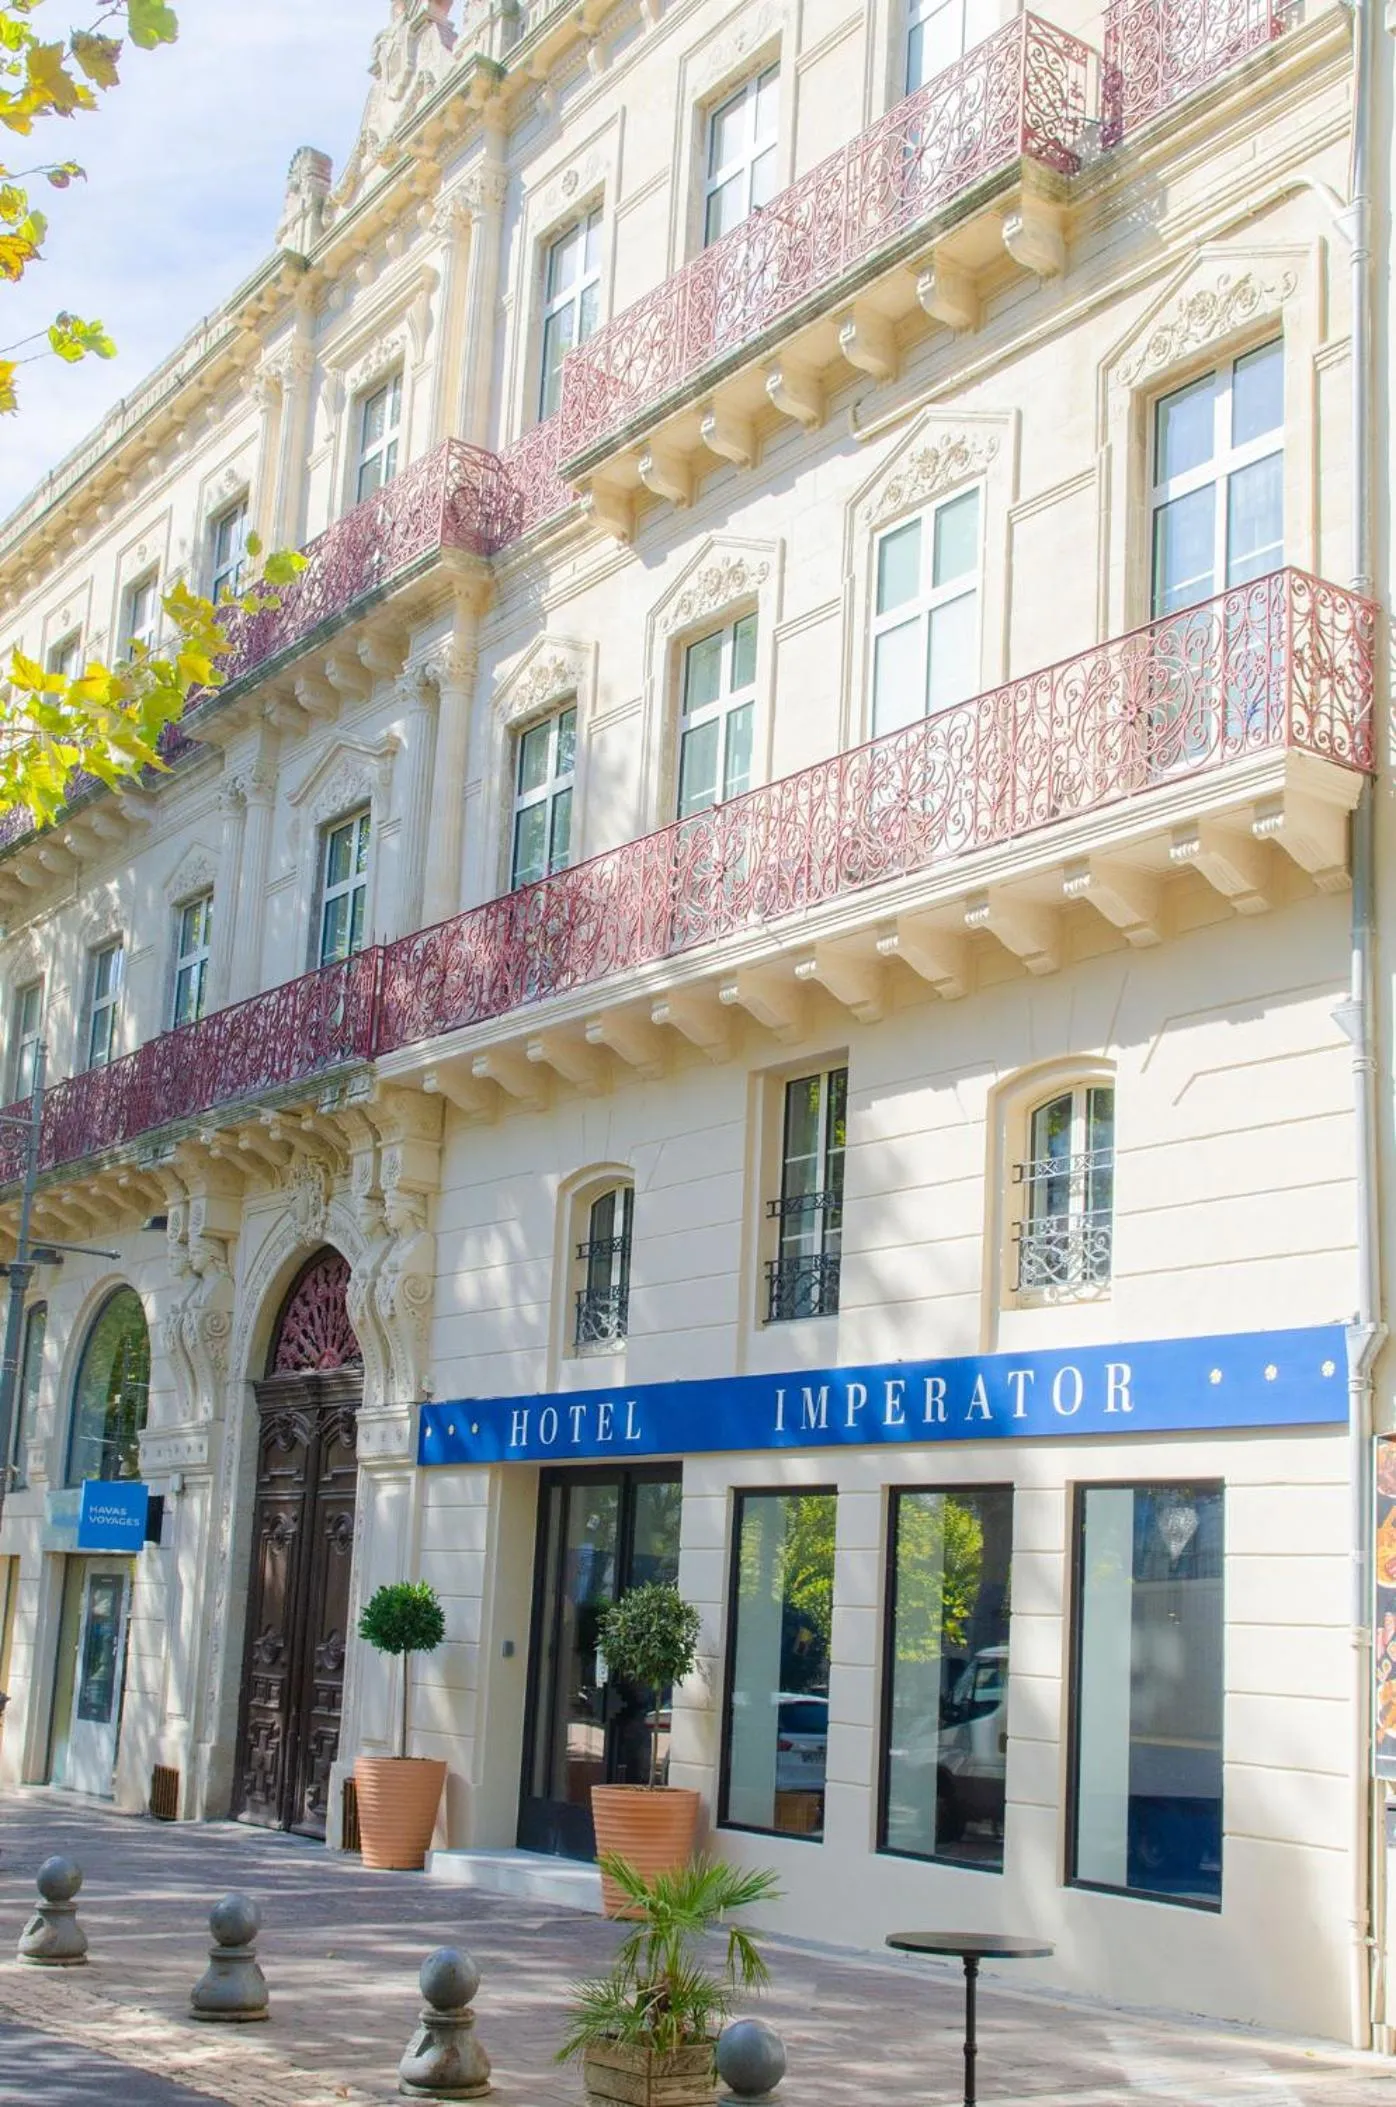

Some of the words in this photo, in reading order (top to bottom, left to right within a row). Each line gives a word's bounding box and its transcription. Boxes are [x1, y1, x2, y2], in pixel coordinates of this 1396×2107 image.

[510, 1401, 641, 1447] HOTEL
[775, 1362, 1134, 1431] IMPERATOR
[89, 1505, 127, 1516] HAVAS
[89, 1515, 140, 1526] VOYAGES
